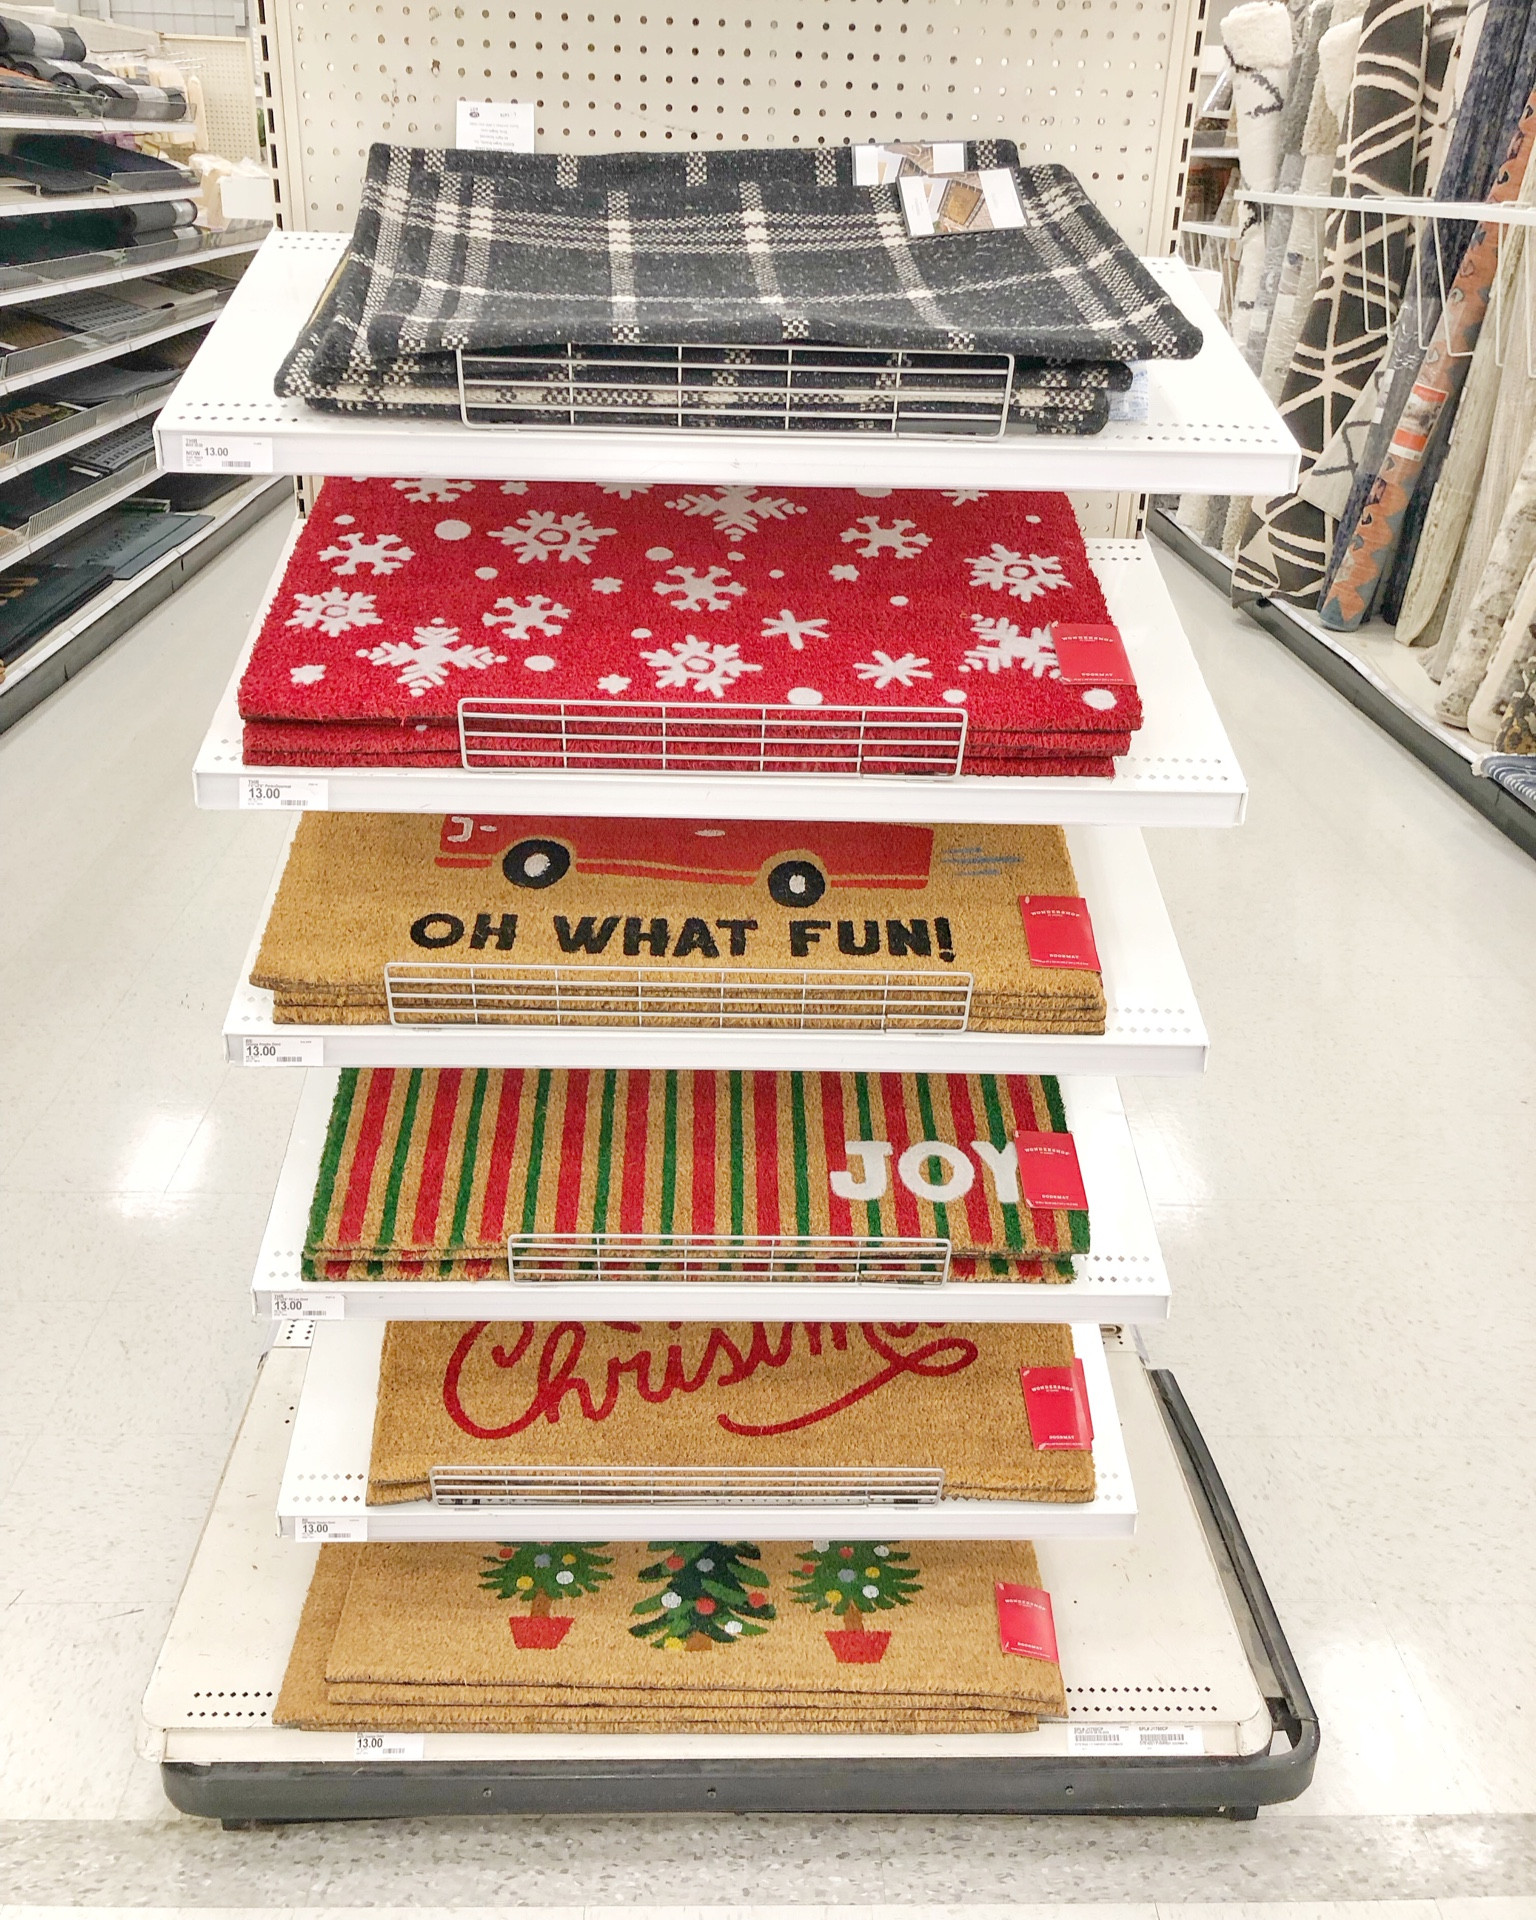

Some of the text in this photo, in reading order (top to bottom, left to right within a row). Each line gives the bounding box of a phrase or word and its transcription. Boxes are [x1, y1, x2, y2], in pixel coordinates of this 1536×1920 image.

[204, 446, 229, 457] 13.00
[248, 787, 280, 799] 13.00
[410, 913, 956, 963] OH WHAT FUN!
[246, 1045, 276, 1056] 13.00
[829, 1140, 1020, 1203] JOY
[274, 1300, 302, 1311] 13.00
[443, 1321, 978, 1439] Chris
[302, 1523, 329, 1533] 13.00
[357, 1738, 383, 1749] 13.00
